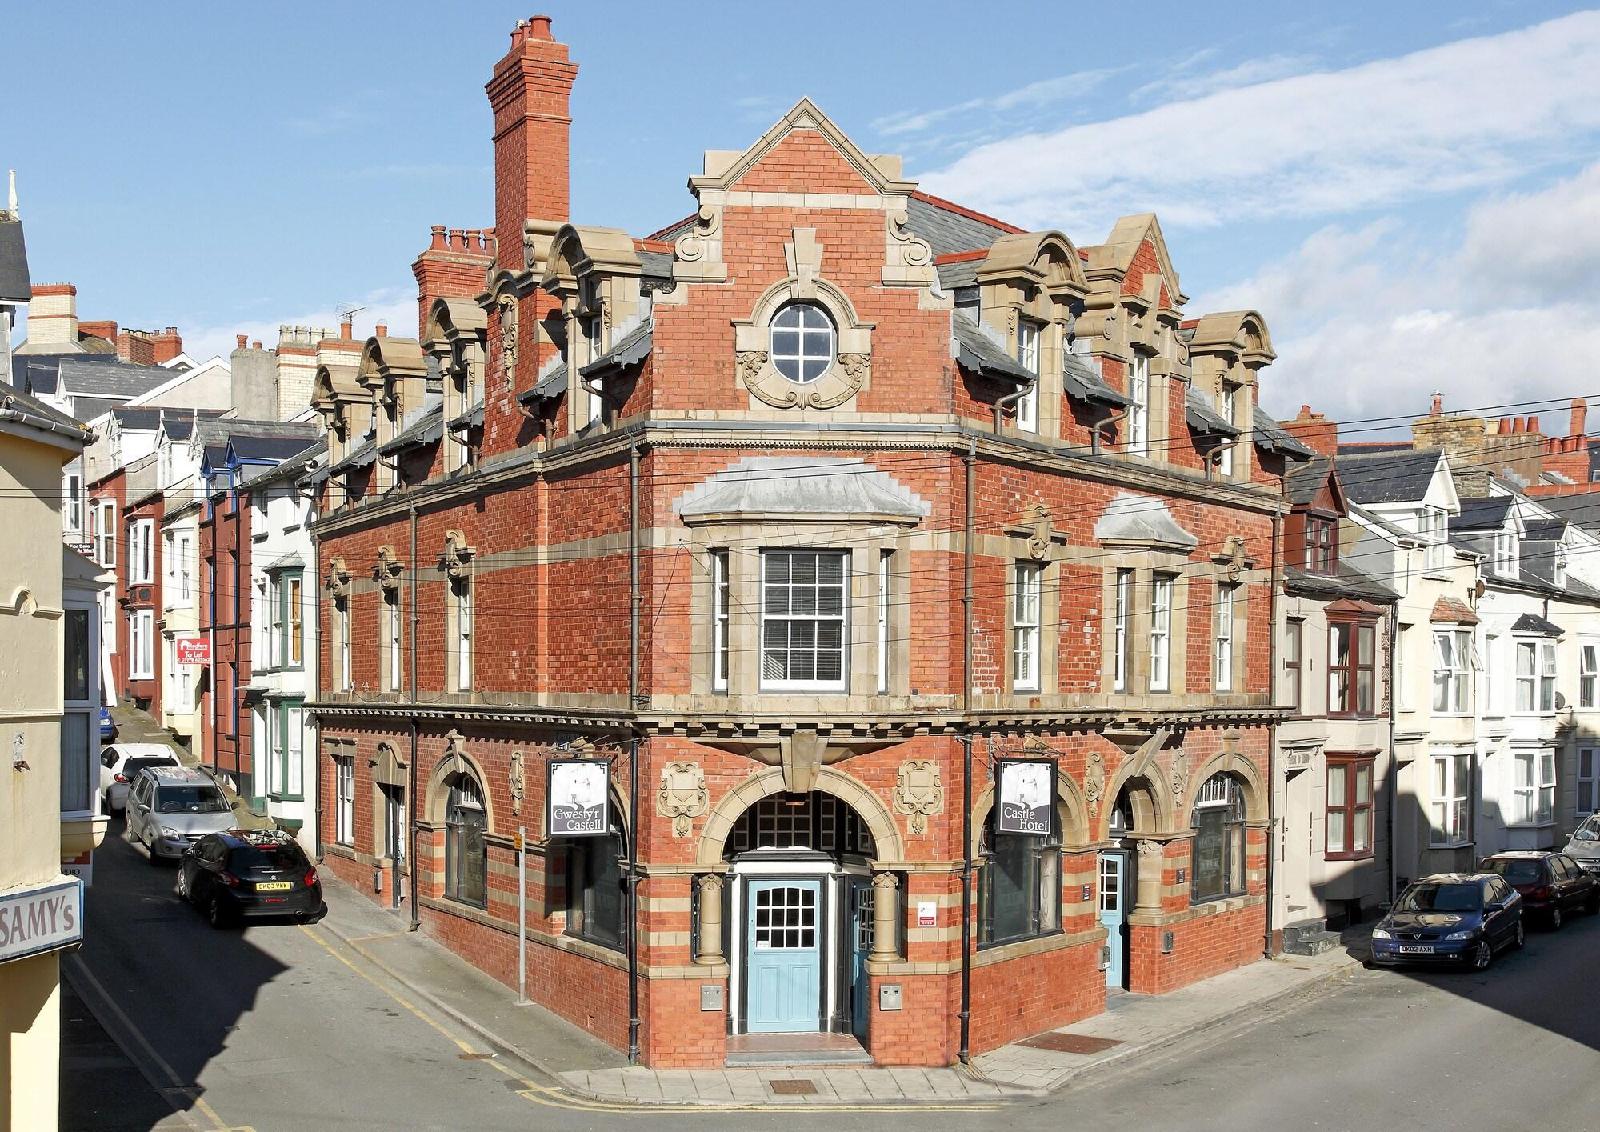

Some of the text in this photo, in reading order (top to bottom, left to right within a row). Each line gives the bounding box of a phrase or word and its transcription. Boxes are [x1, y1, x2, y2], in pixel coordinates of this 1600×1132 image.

[554, 808, 600, 821] Gwesty'r
[1004, 807, 1035, 820] Castle
[567, 819, 601, 831] Castell
[1019, 819, 1048, 831] Hotel
